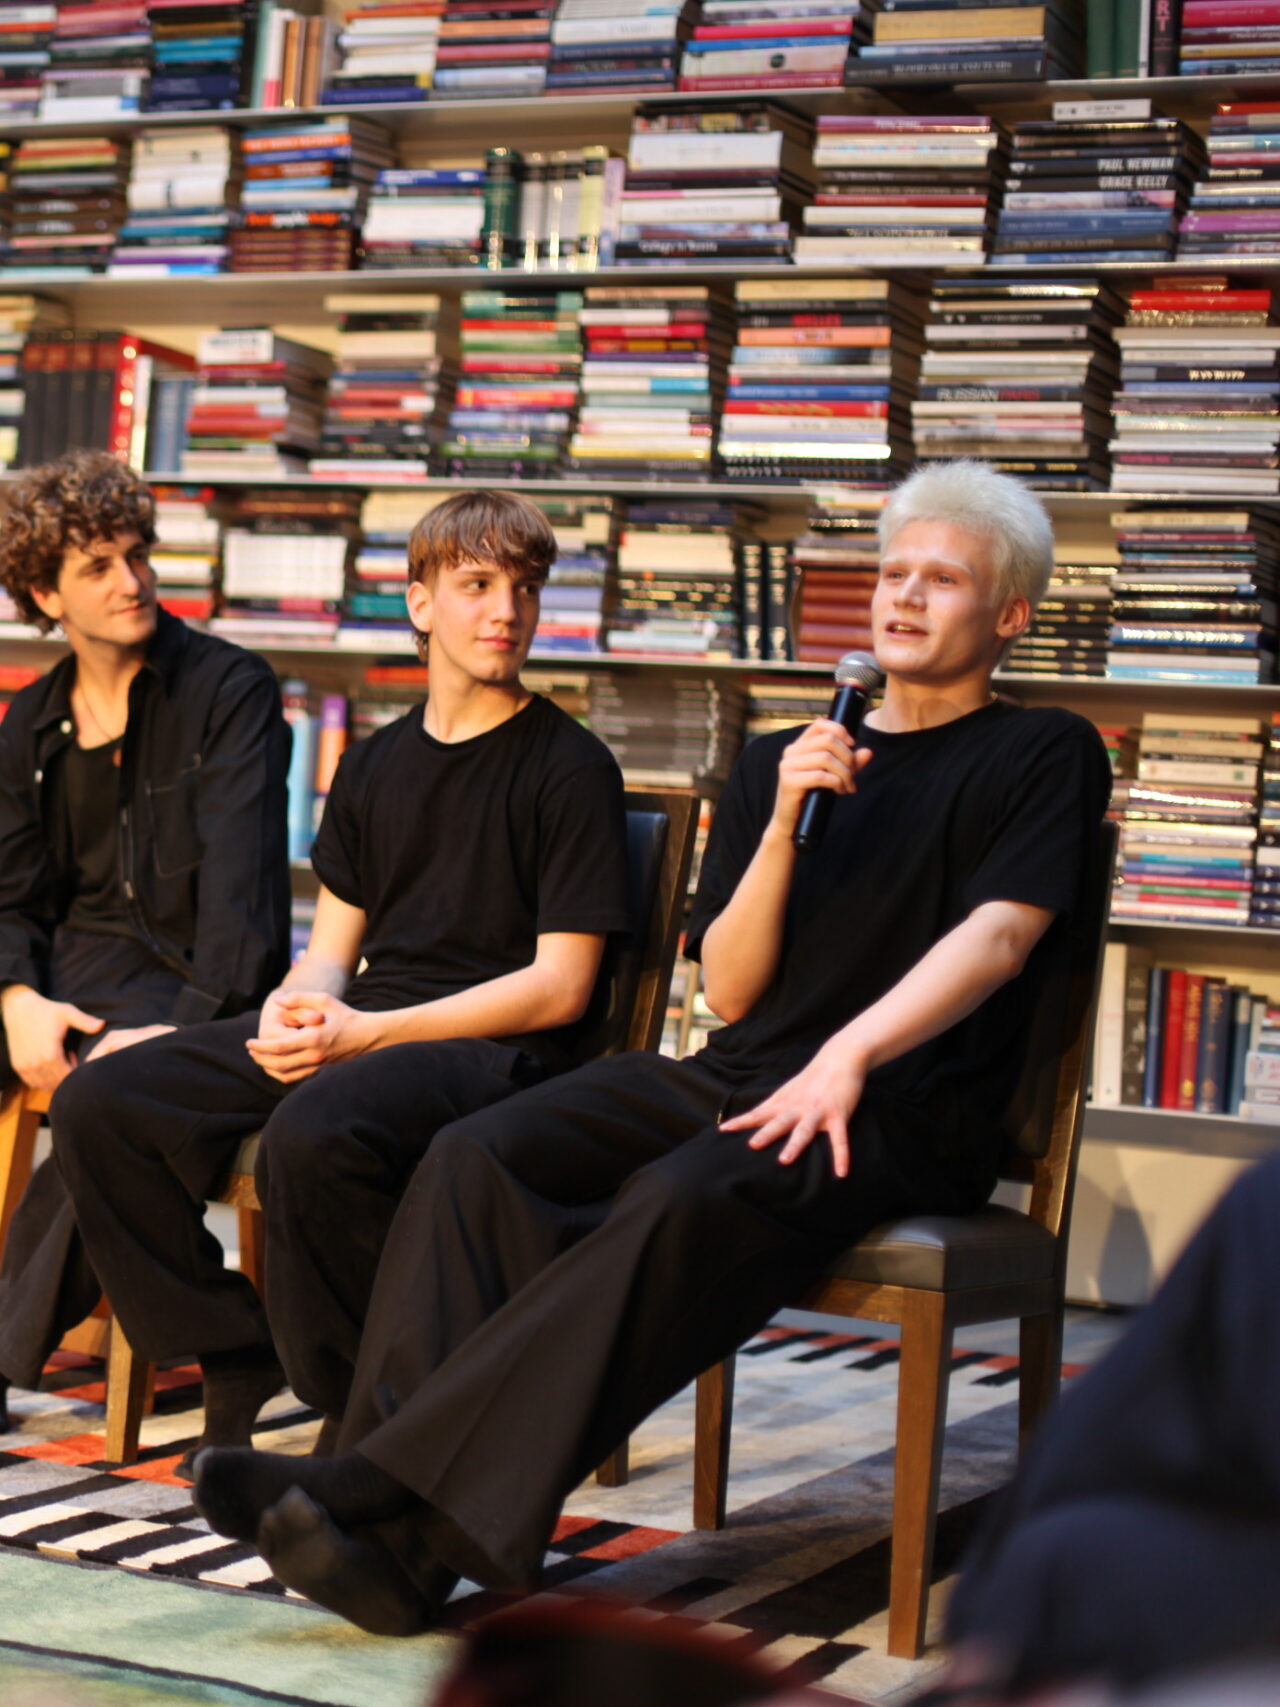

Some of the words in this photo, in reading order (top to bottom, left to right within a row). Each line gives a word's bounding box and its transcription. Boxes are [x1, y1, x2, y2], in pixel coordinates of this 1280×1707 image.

[1097, 158, 1124, 172] PAUL
[1127, 157, 1175, 171] NEWMAN
[1098, 176, 1134, 189] GRACE
[1135, 175, 1169, 188] KELLY
